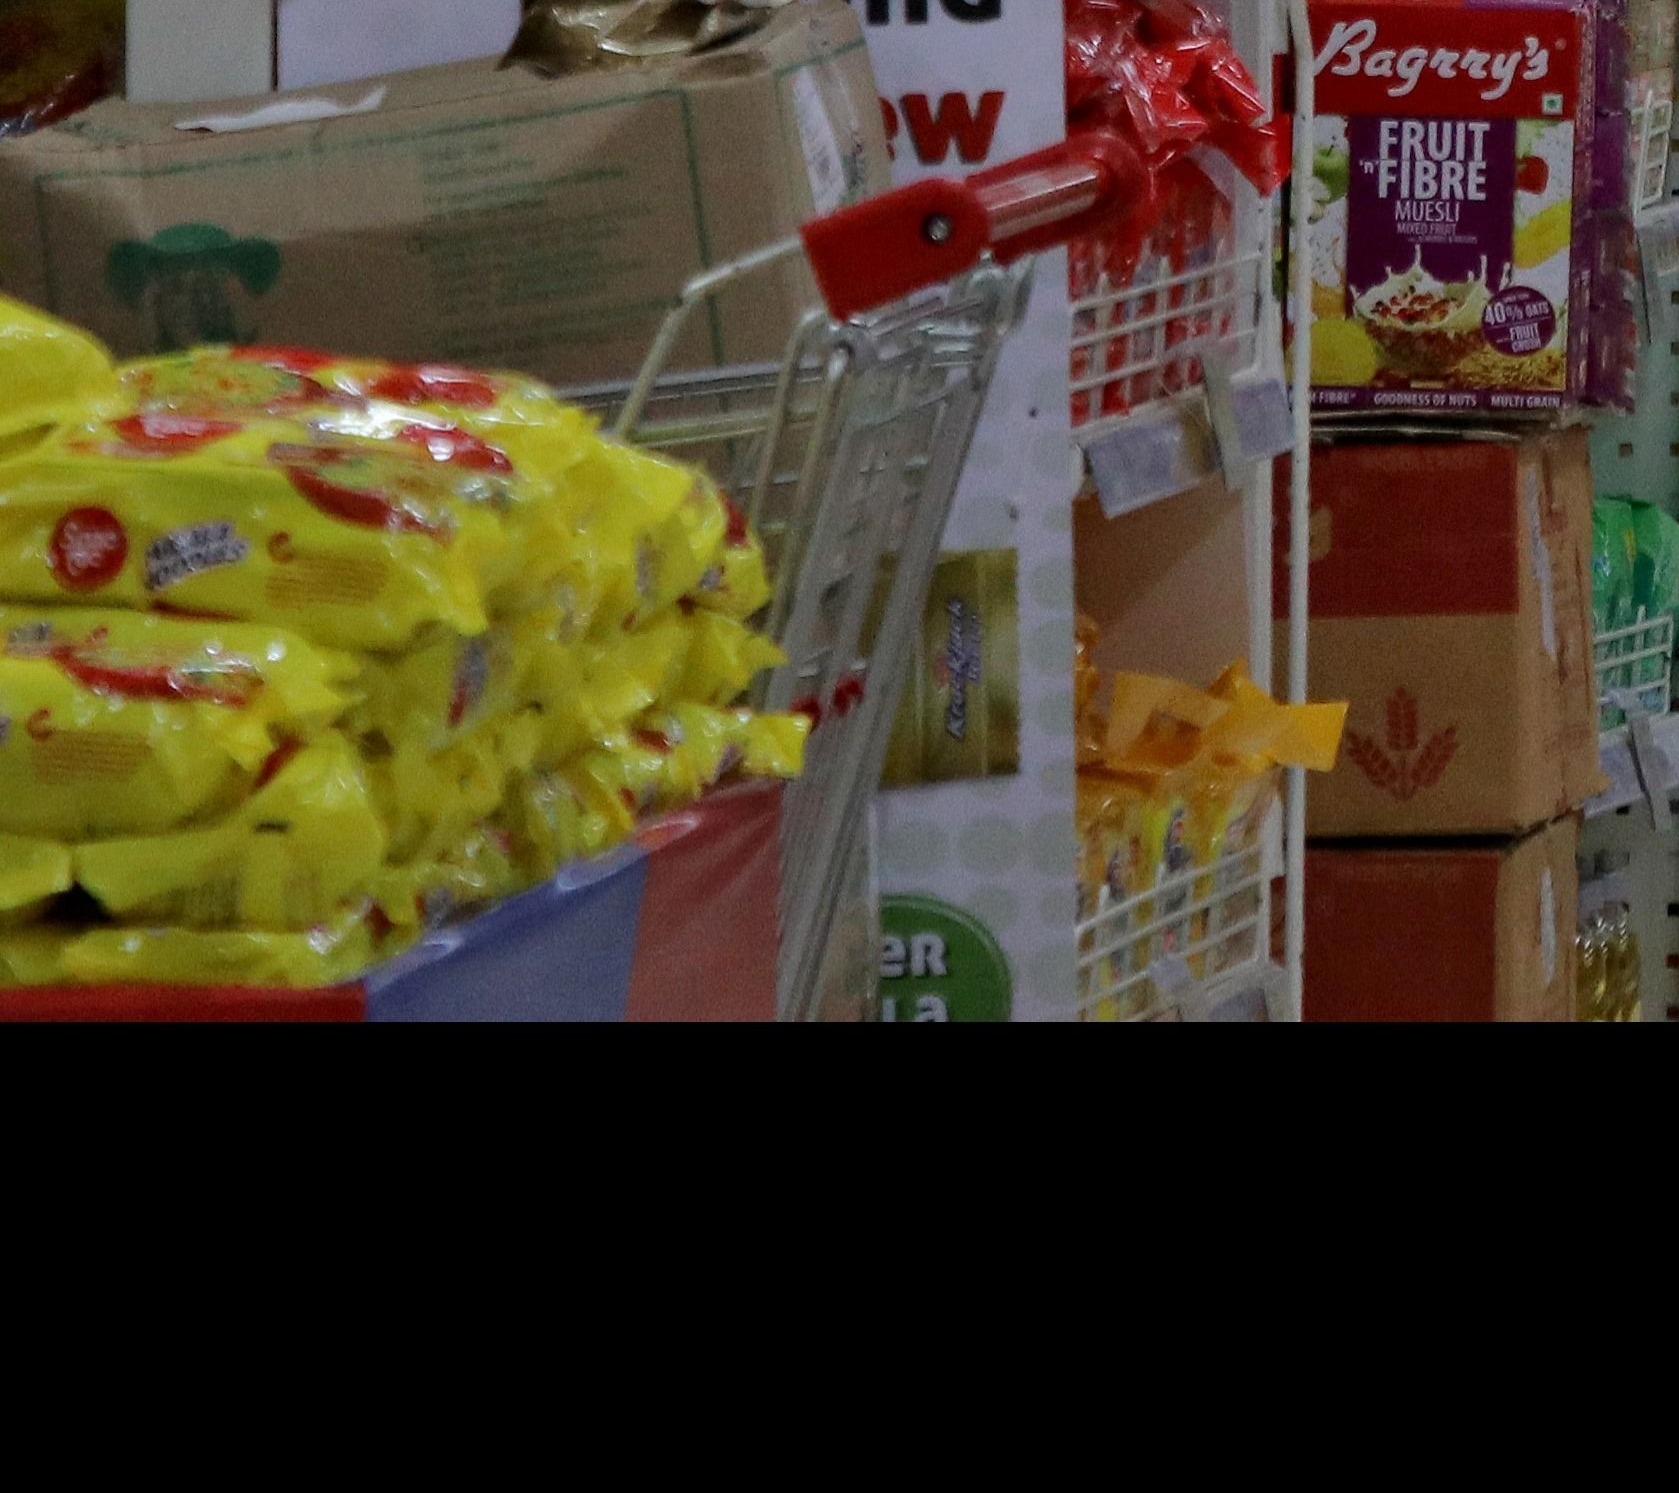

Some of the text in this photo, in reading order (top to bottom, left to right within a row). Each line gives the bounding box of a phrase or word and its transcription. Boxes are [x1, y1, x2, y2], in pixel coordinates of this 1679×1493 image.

[1312, 17, 1549, 100] Bagrry's
[1378, 120, 1491, 163] FRUIT
[1377, 159, 1488, 201] FIBRE
[1394, 200, 1461, 223] MUESLI
[1396, 222, 1458, 236] MIXED FRUIT
[1524, 301, 1550, 317] OATS
[1508, 325, 1540, 342] FRUIT
[1373, 392, 1431, 406] GOODNESS
[1432, 394, 1447, 406] OF
[1448, 394, 1477, 407] NUTS
[1490, 395, 1525, 408] MULTI
[1526, 396, 1563, 409] GRAIN
